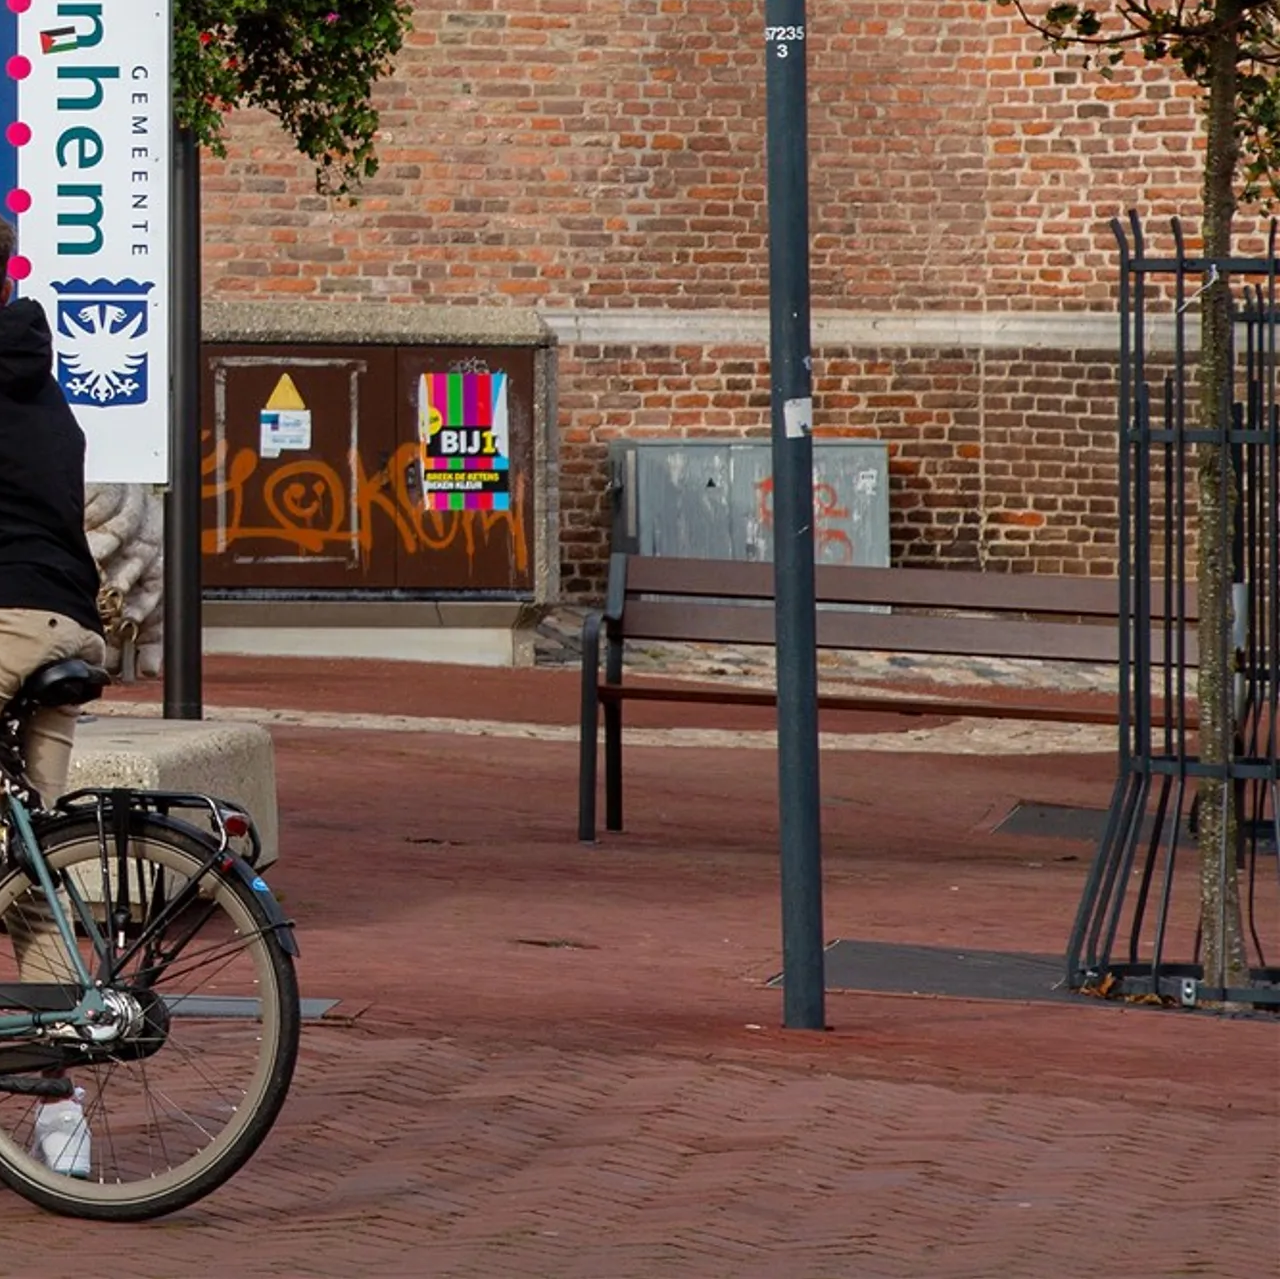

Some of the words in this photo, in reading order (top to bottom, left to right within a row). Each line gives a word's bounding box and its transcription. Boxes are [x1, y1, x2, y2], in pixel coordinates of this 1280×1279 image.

[777, 44, 787, 57] 3
[131, 65, 148, 256] GEMEENTE
[441, 430, 496, 454] BIJ1
